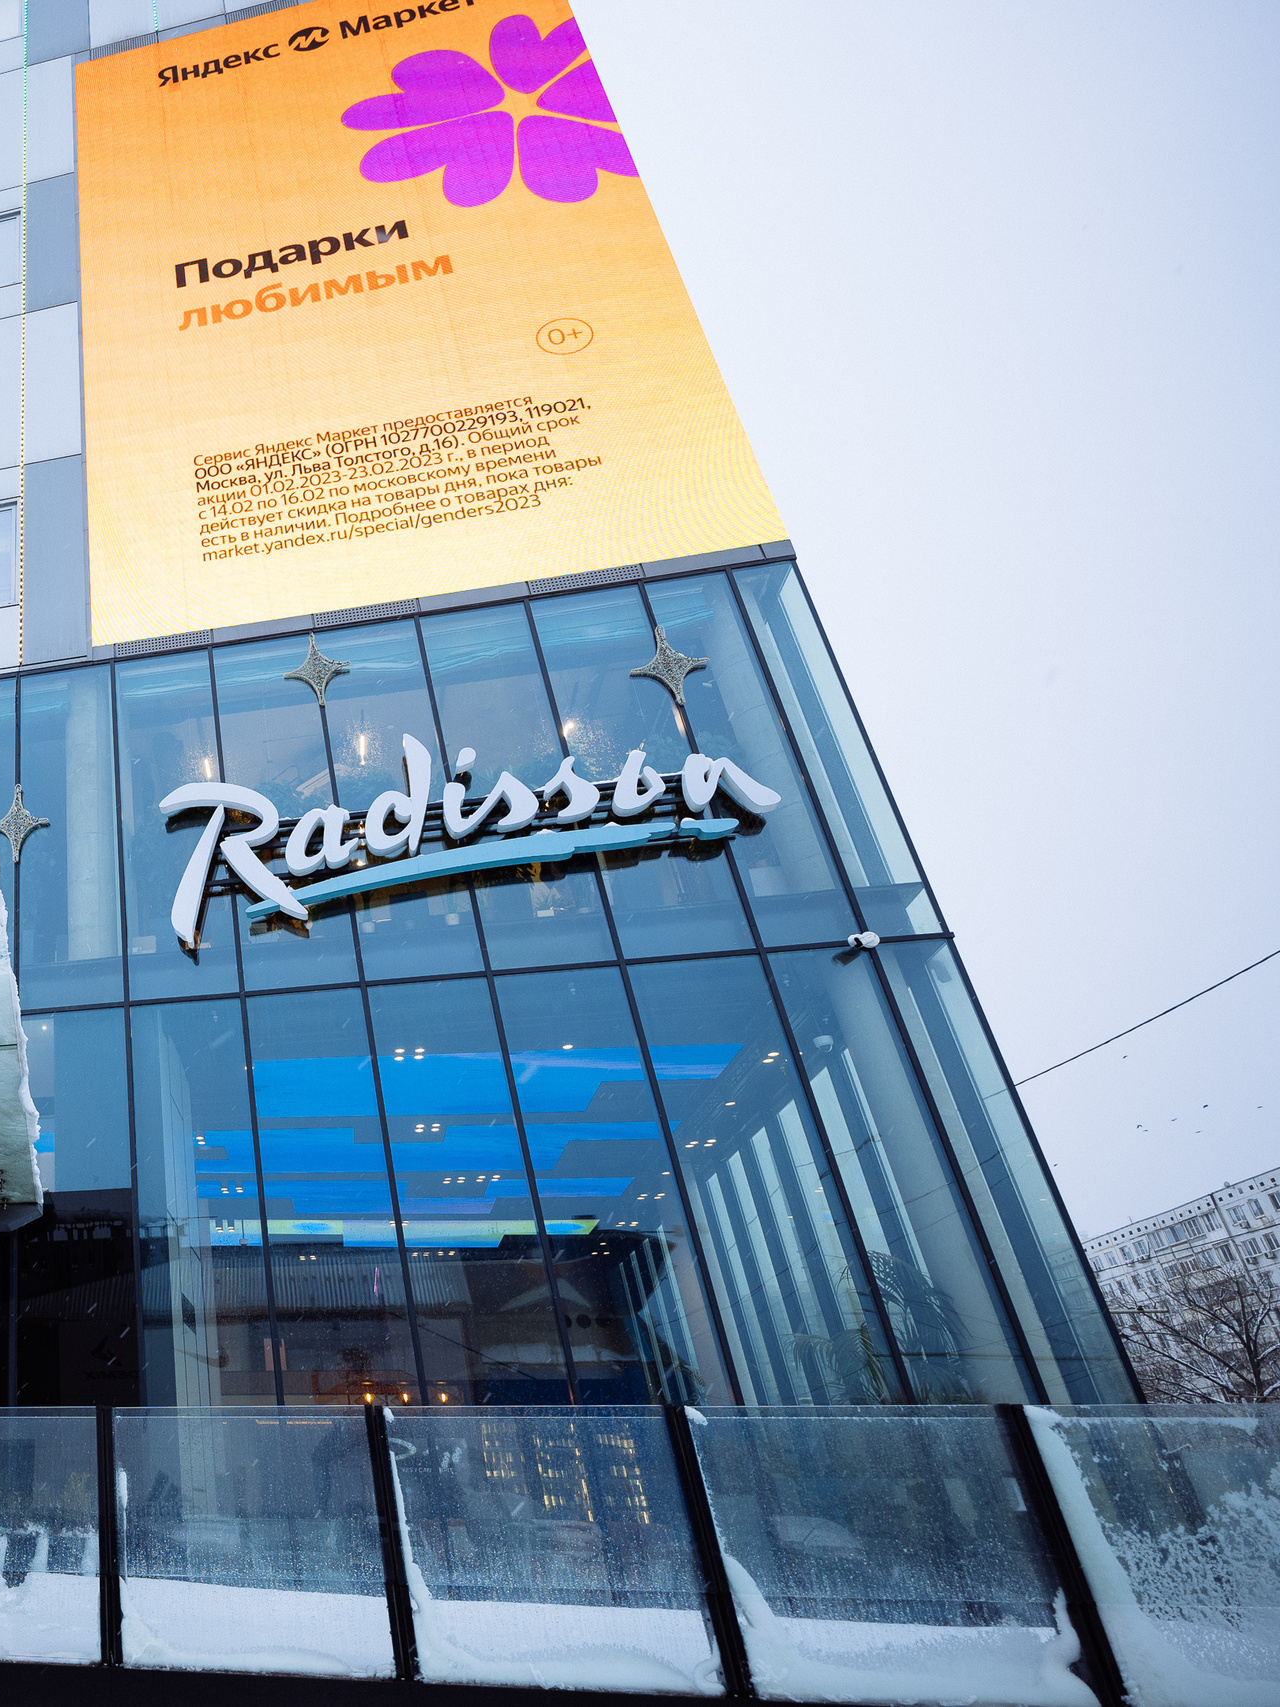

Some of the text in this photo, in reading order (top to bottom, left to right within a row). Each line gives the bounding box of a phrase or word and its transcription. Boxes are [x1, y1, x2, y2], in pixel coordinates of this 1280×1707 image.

[157, 41, 281, 87] Яндекс
[174, 219, 410, 289] Подарки
[178, 254, 454, 332] любимым
[547, 328, 583, 345] 0+
[193, 396, 533, 467] Сервис Яндекс Маркет предоставляется
[194, 397, 591, 480] ООО «ЯНДЕКС» (ОГРН 1027700229193, 119021,
[196, 474, 261, 493] Москва,
[264, 469, 288, 484] ул.
[291, 460, 331, 477] Льва
[333, 446, 415, 468] Толстого,
[467, 421, 533, 444] Общий
[536, 415, 581, 433] срок
[197, 490, 247, 507] акции
[250, 452, 443, 497] 01.02.2023-23.02.2023
[466, 449, 477, 459] в
[480, 436, 551, 456] период
[198, 449, 557, 520] с 14.02 по 16.02 по московскому времени
[199, 455, 602, 536] действует скидка на товары дня, пока товары
[201, 476, 574, 548] есть в наличии. Подробнее о товарах дня:
[202, 494, 541, 562] market.yandex.ru/special/genders2023
[158, 732, 782, 949] Radisson
